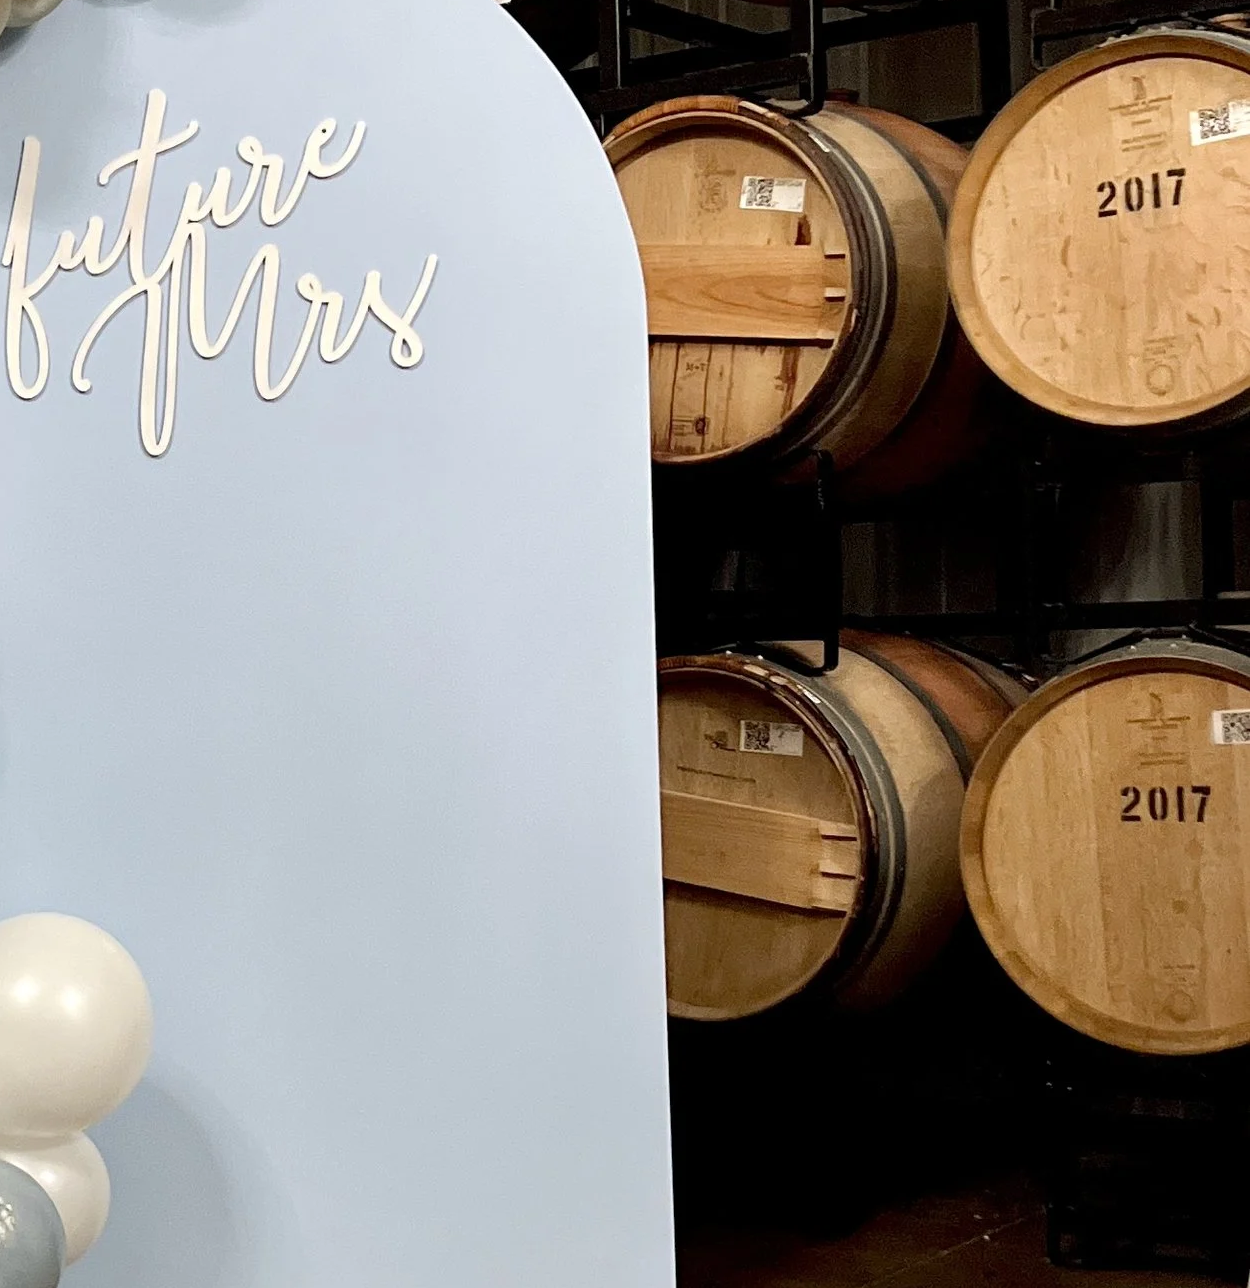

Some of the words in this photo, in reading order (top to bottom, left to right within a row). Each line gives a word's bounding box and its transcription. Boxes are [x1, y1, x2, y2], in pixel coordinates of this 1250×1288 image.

[1, 88, 367, 401] future
[1096, 167, 1186, 218] 2017
[71, 221, 439, 457] Mrs
[1120, 785, 1211, 823] 2017
